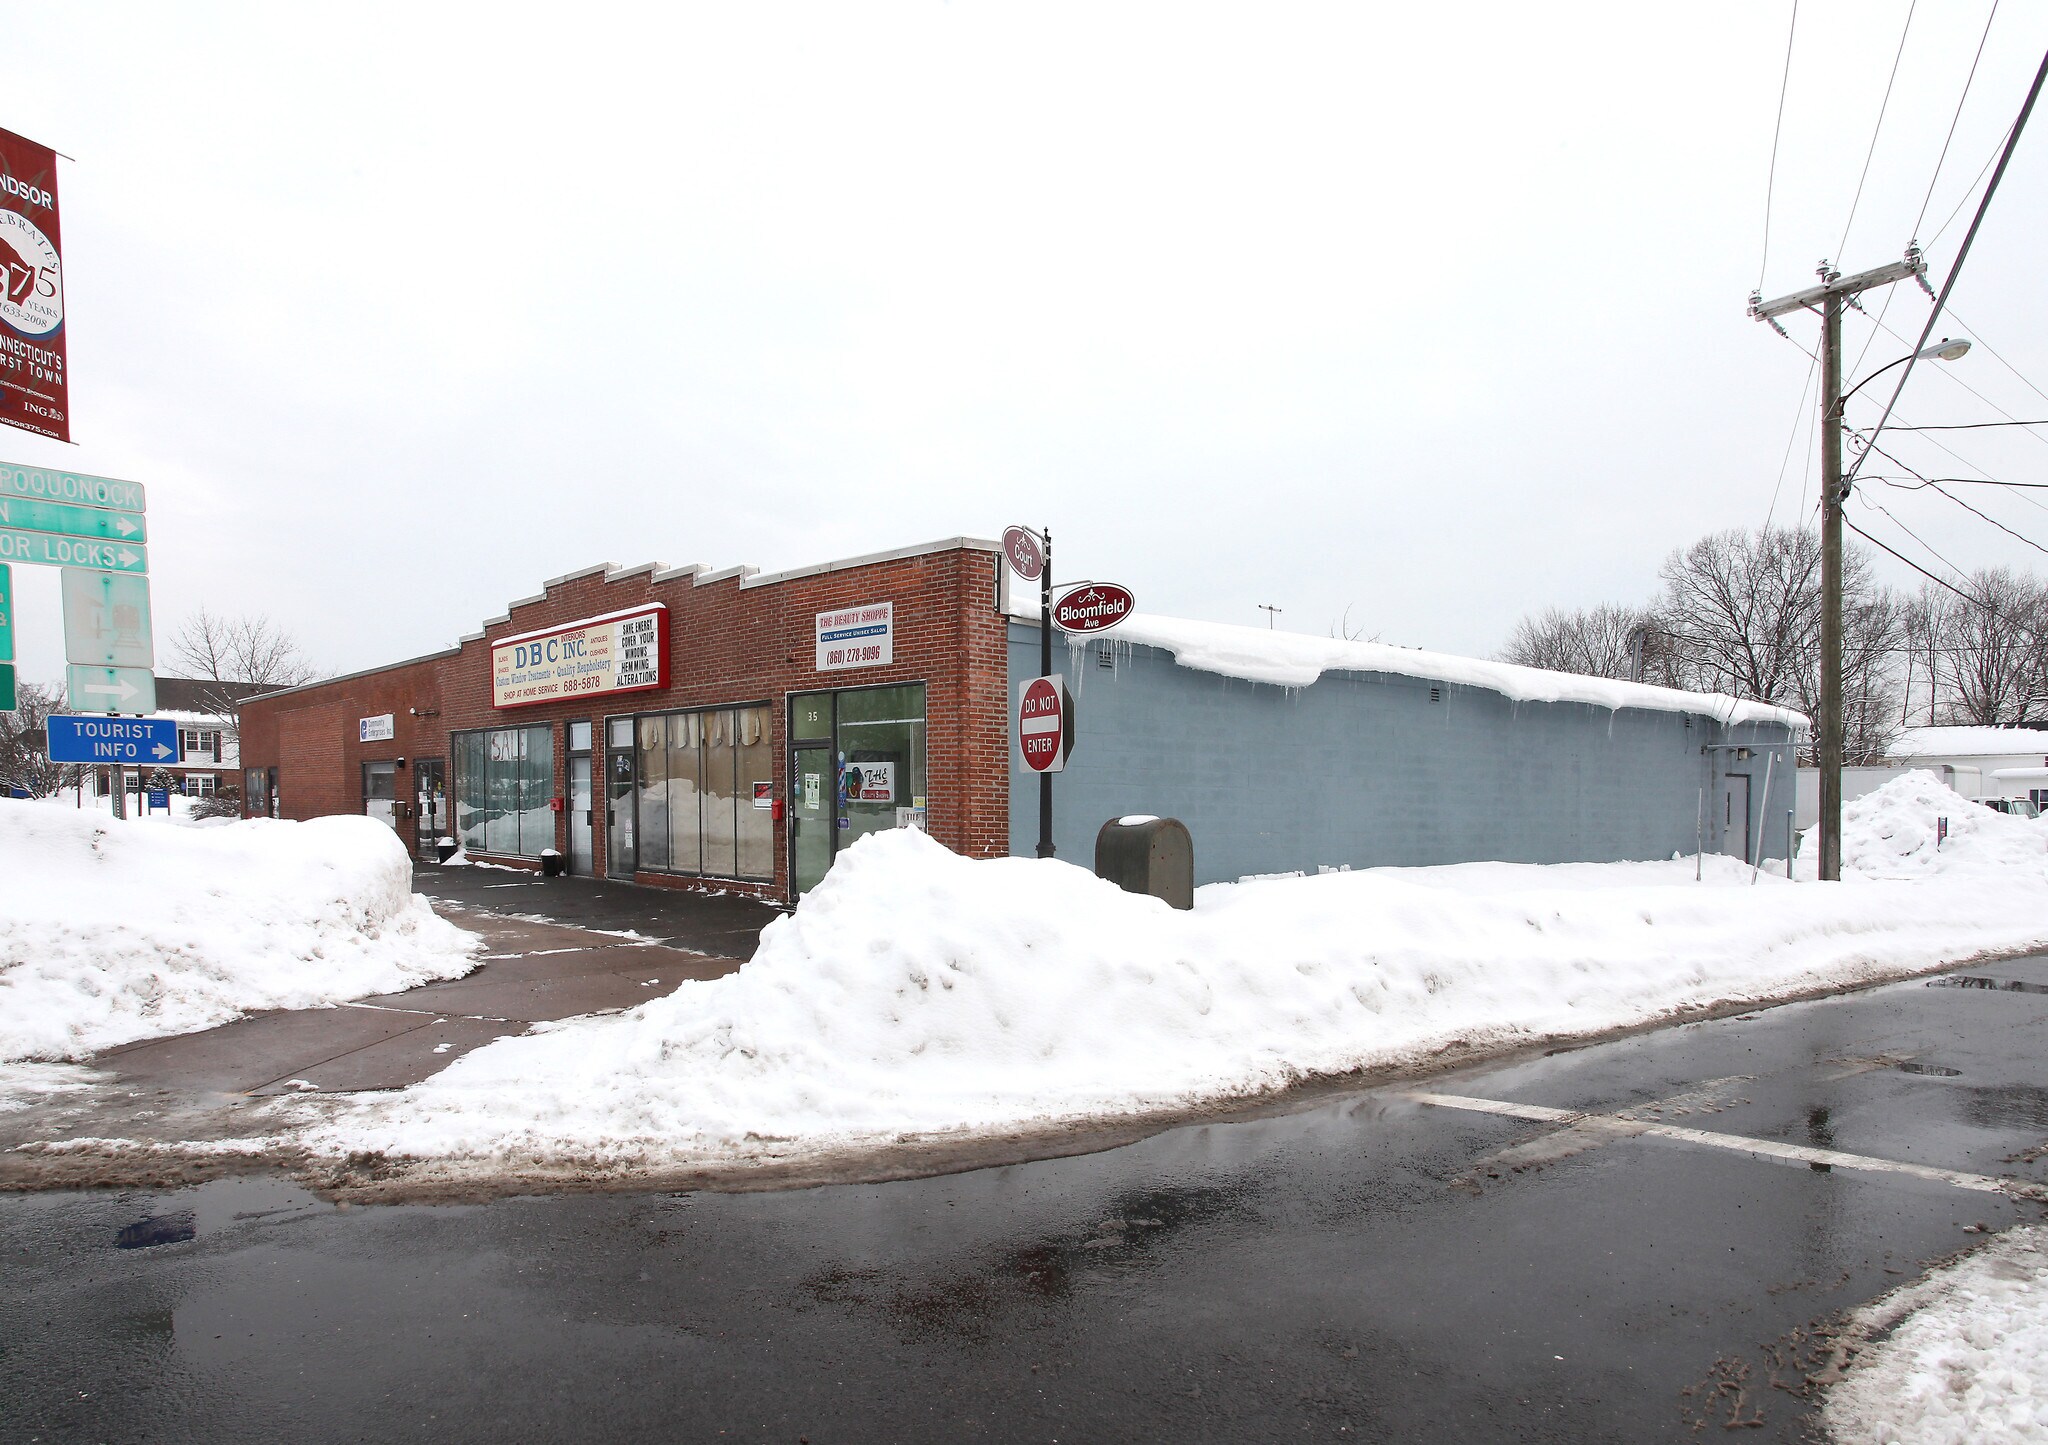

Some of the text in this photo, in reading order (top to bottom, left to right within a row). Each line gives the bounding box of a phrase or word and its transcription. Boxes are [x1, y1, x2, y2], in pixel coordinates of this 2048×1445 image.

[27, 299, 58, 318] YEARS
[28, 360, 62, 386] TOWN
[24, 401, 48, 417] ING
[44, 539, 117, 567] LOCKS
[1014, 544, 1033, 567] Court
[820, 607, 888, 628] THE BEAUTY SHOPPE
[1060, 597, 1125, 621] Bloomfield
[622, 618, 653, 635] SAVE ENERGY
[1084, 619, 1100, 628] Ave
[560, 630, 586, 643] INTERIORS
[639, 631, 655, 644] YOUR
[562, 639, 587, 660] INC.
[624, 645, 648, 659] WINDOWS
[826, 645, 880, 666] (860) 278-9096
[556, 664, 576, 677] Quality
[576, 659, 611, 675] Reupholstery
[621, 658, 650, 673] HEMMING
[616, 670, 657, 687] ALTERATIONS
[503, 675, 601, 700] SHOP AT HOME SERVICE 688-5878
[1025, 695, 1055, 713] DO NOT
[808, 711, 818, 722] 35
[73, 722, 154, 739] TOURIST
[94, 742, 137, 757] INFO
[491, 731, 526, 761] SALE
[1027, 737, 1053, 753] ENTER
[864, 767, 888, 783] THE
